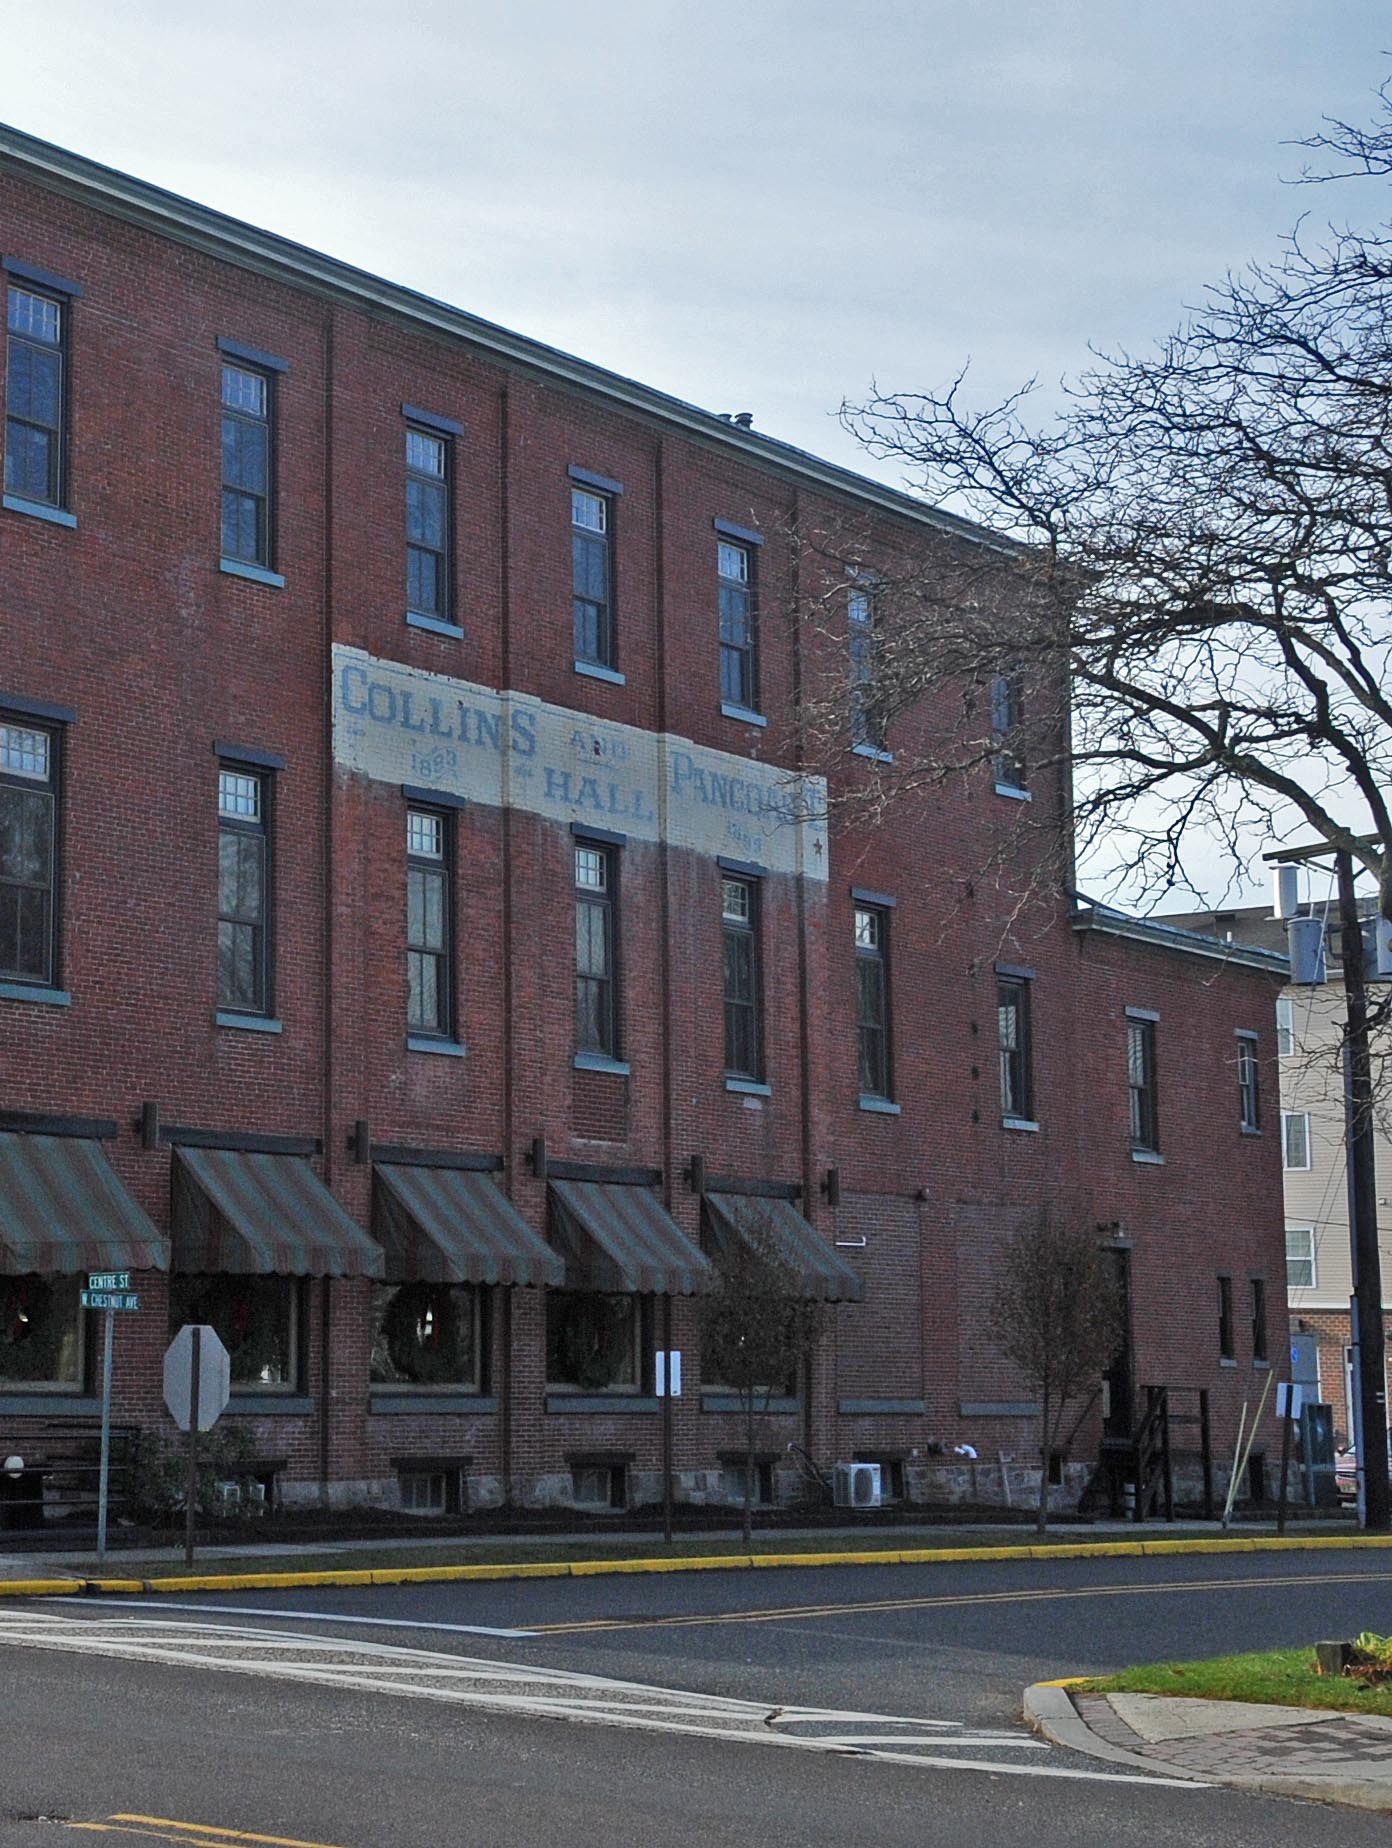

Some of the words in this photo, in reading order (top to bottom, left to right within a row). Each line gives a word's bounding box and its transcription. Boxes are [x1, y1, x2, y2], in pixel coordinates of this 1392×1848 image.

[341, 665, 537, 758] COLLINS
[543, 766, 654, 821] HALL
[89, 1276, 116, 1288] CENTRE
[120, 1275, 128, 1288] ST
